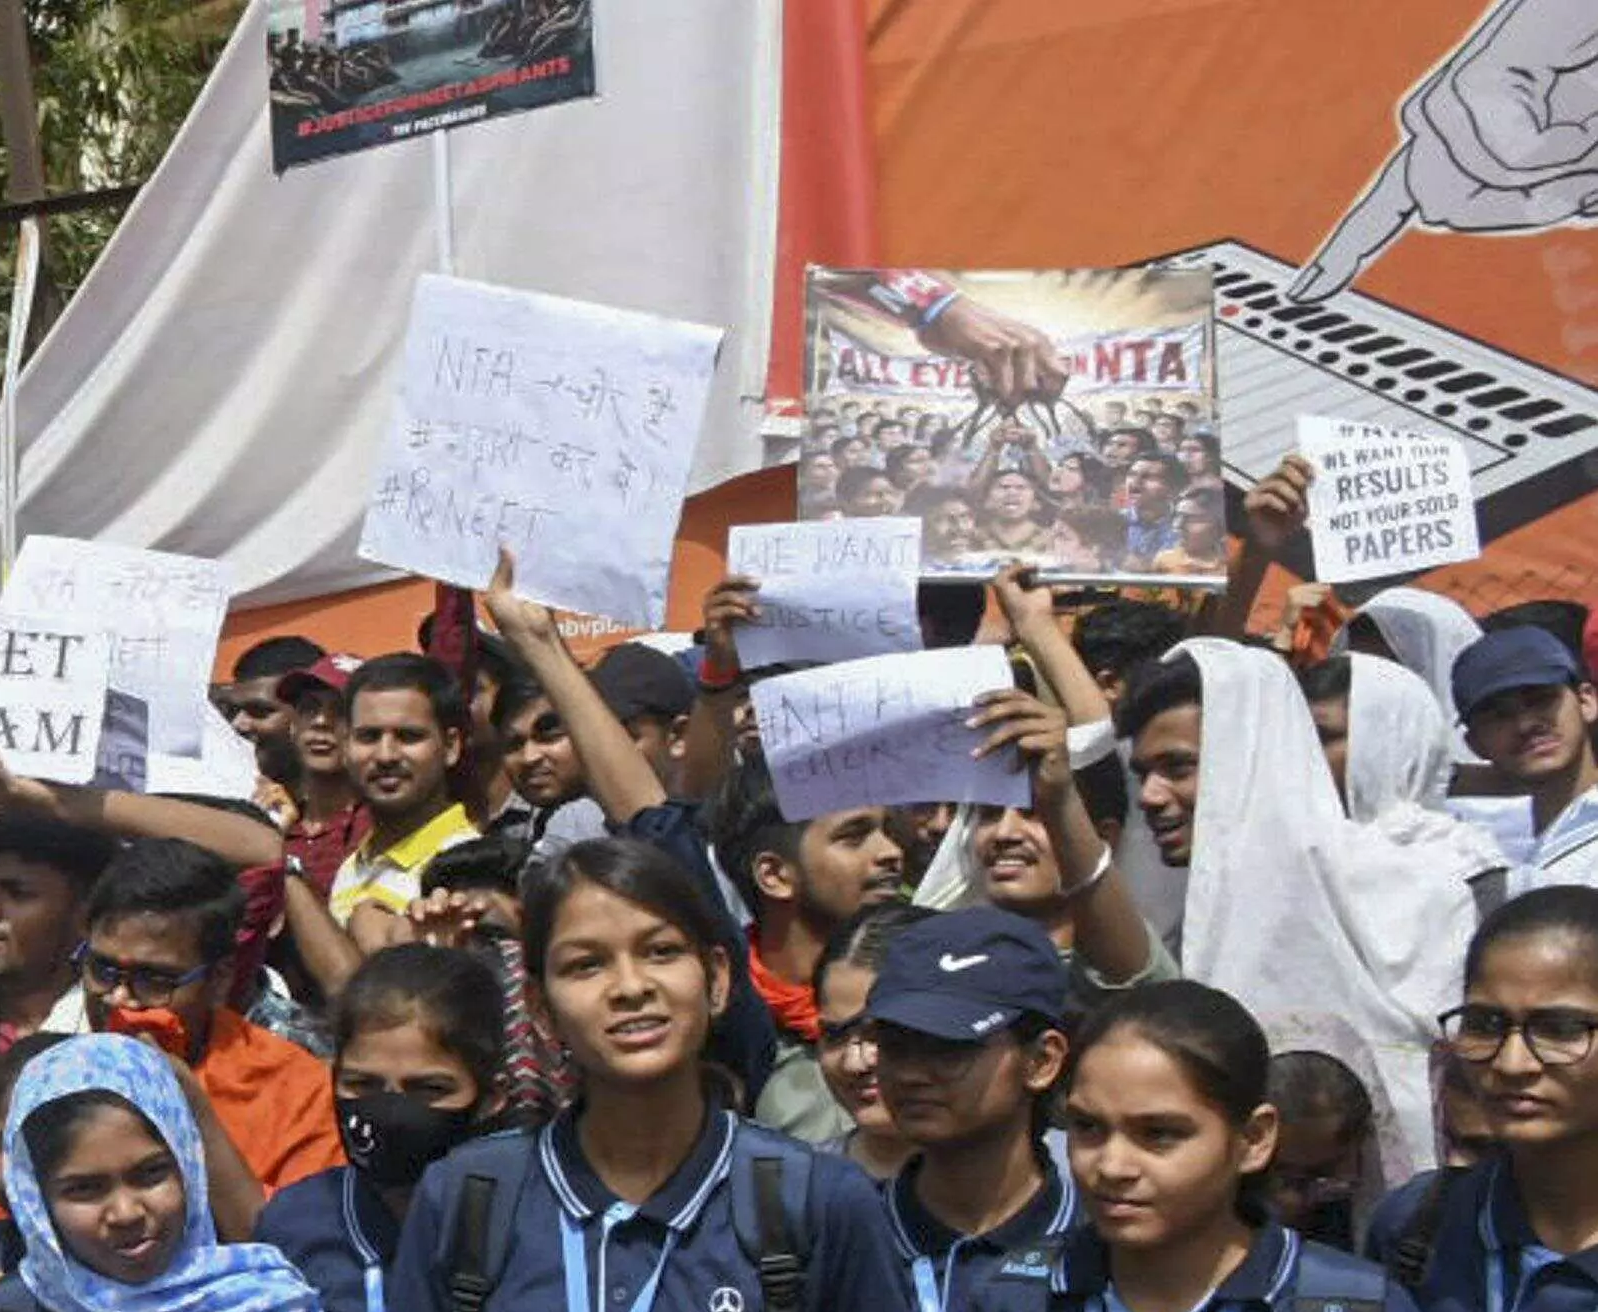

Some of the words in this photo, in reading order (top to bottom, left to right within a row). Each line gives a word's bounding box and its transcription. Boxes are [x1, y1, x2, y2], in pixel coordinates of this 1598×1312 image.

[837, 346, 897, 387] ALL
[909, 360, 973, 389] EYE
[1094, 338, 1187, 384] NTA
[1356, 446, 1403, 467] WANT
[1335, 460, 1450, 503] RESULTS
[1329, 510, 1360, 531] NOT
[1366, 501, 1411, 525] YOUR
[1415, 491, 1460, 516] SOLD
[1344, 519, 1455, 566] PAPERS
